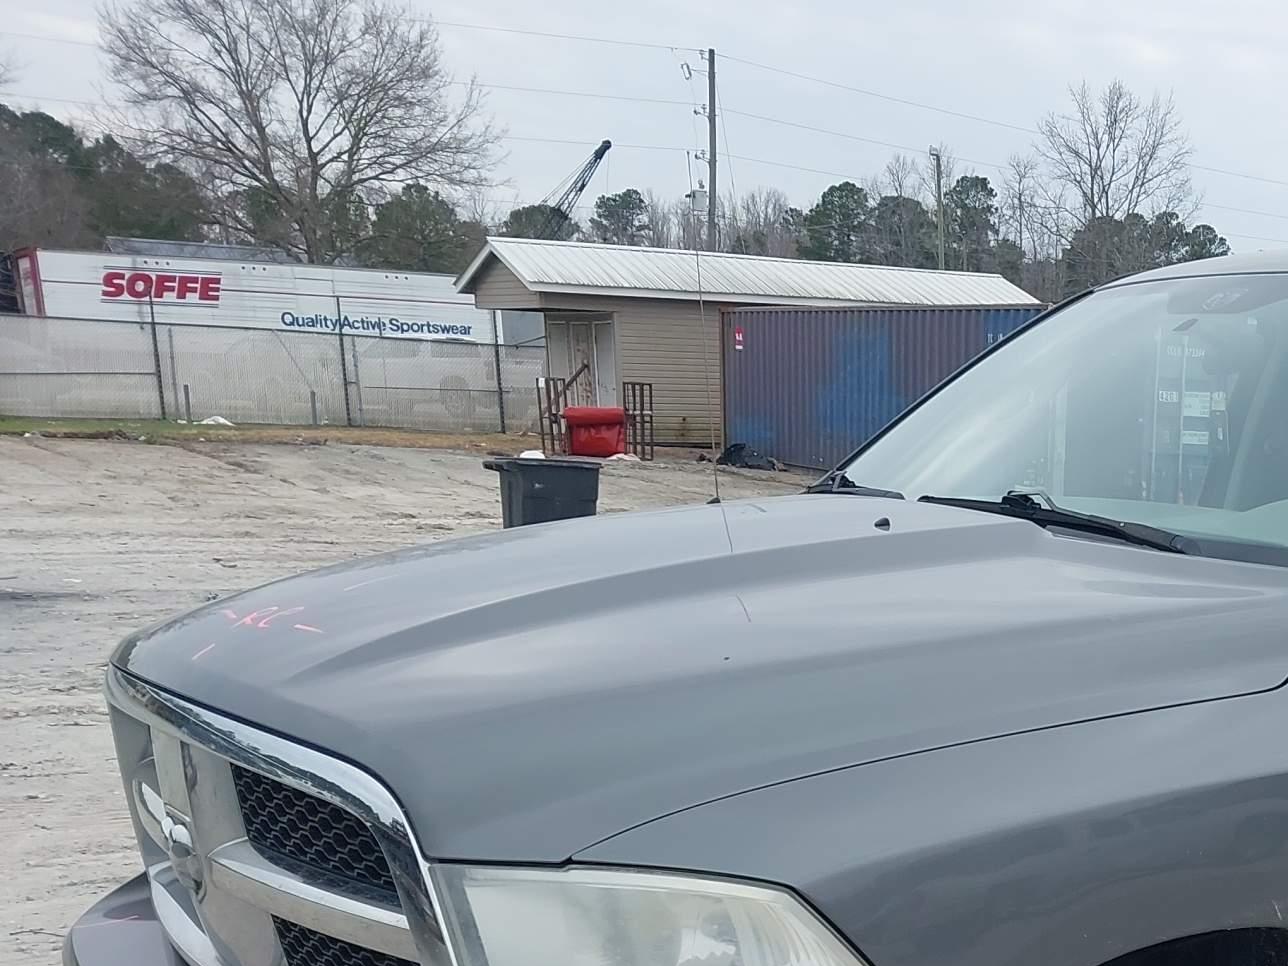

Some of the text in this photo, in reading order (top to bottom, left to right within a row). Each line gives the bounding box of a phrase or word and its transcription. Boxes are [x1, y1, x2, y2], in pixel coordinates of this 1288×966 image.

[101, 271, 222, 301] SOFFE
[281, 310, 473, 337] Quality Active Sportswear
